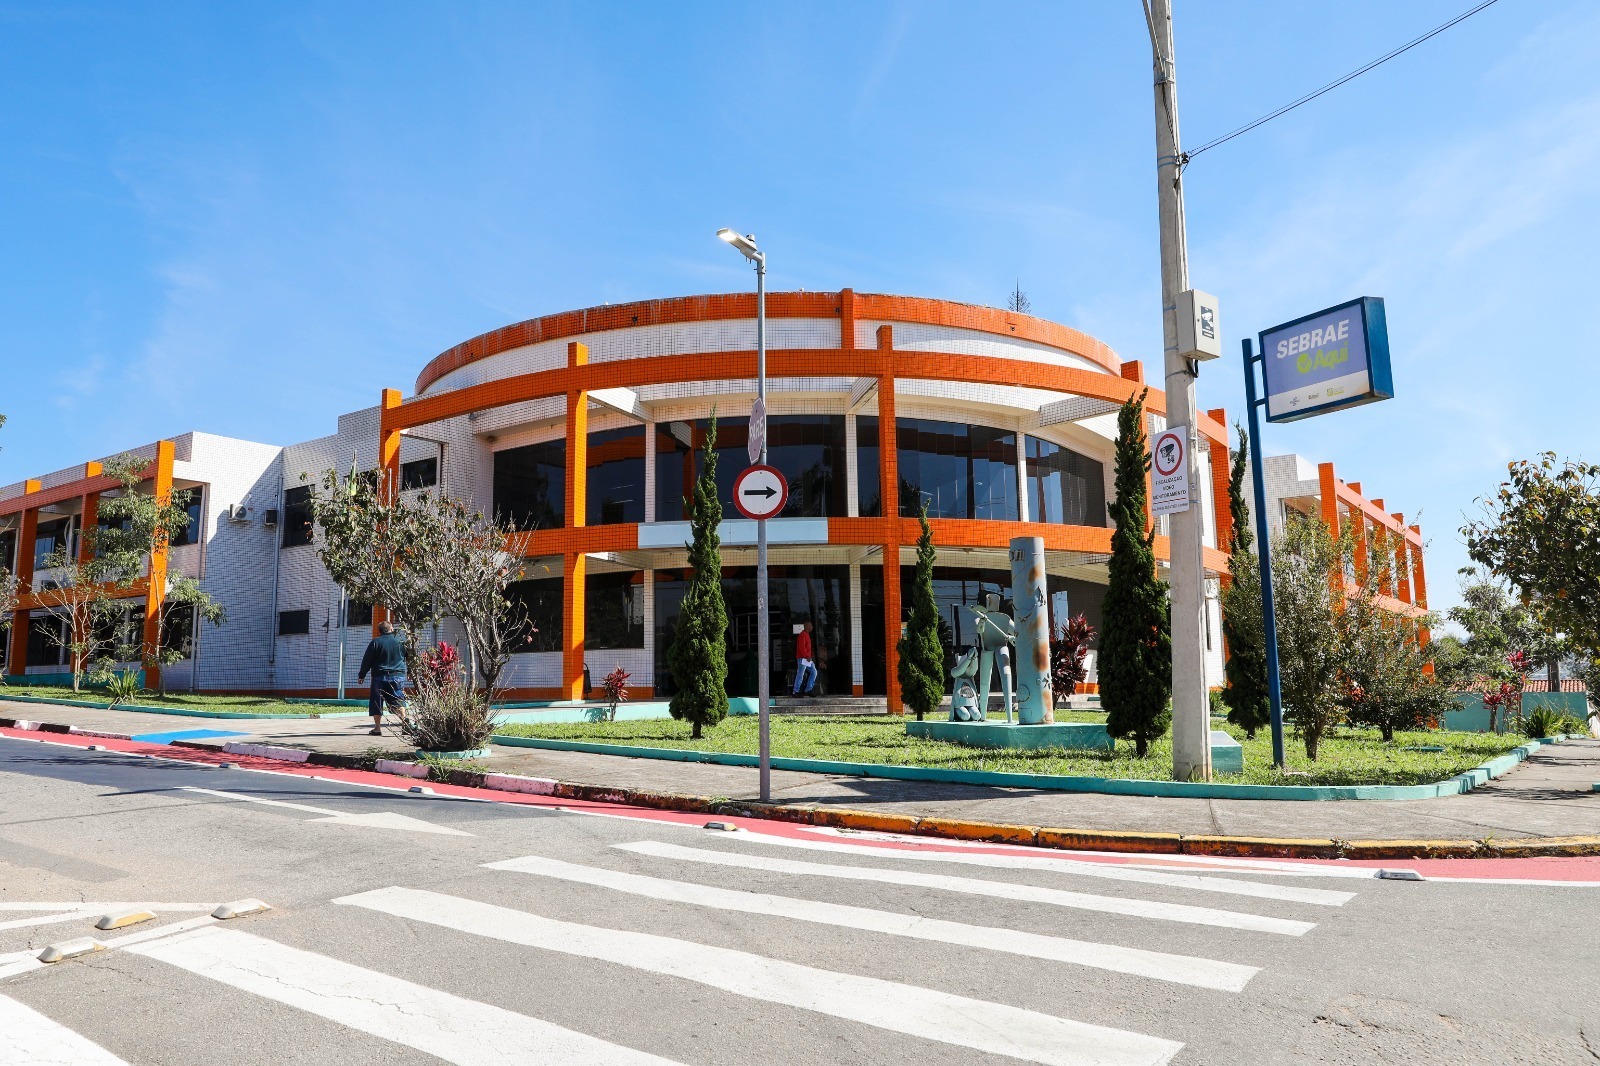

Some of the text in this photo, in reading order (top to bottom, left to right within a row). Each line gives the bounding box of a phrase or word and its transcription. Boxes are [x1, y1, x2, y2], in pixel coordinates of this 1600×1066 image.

[1276, 319, 1350, 359] SEBRAE
[1312, 341, 1348, 371] Aqui
[750, 415, 764, 443] PARE
